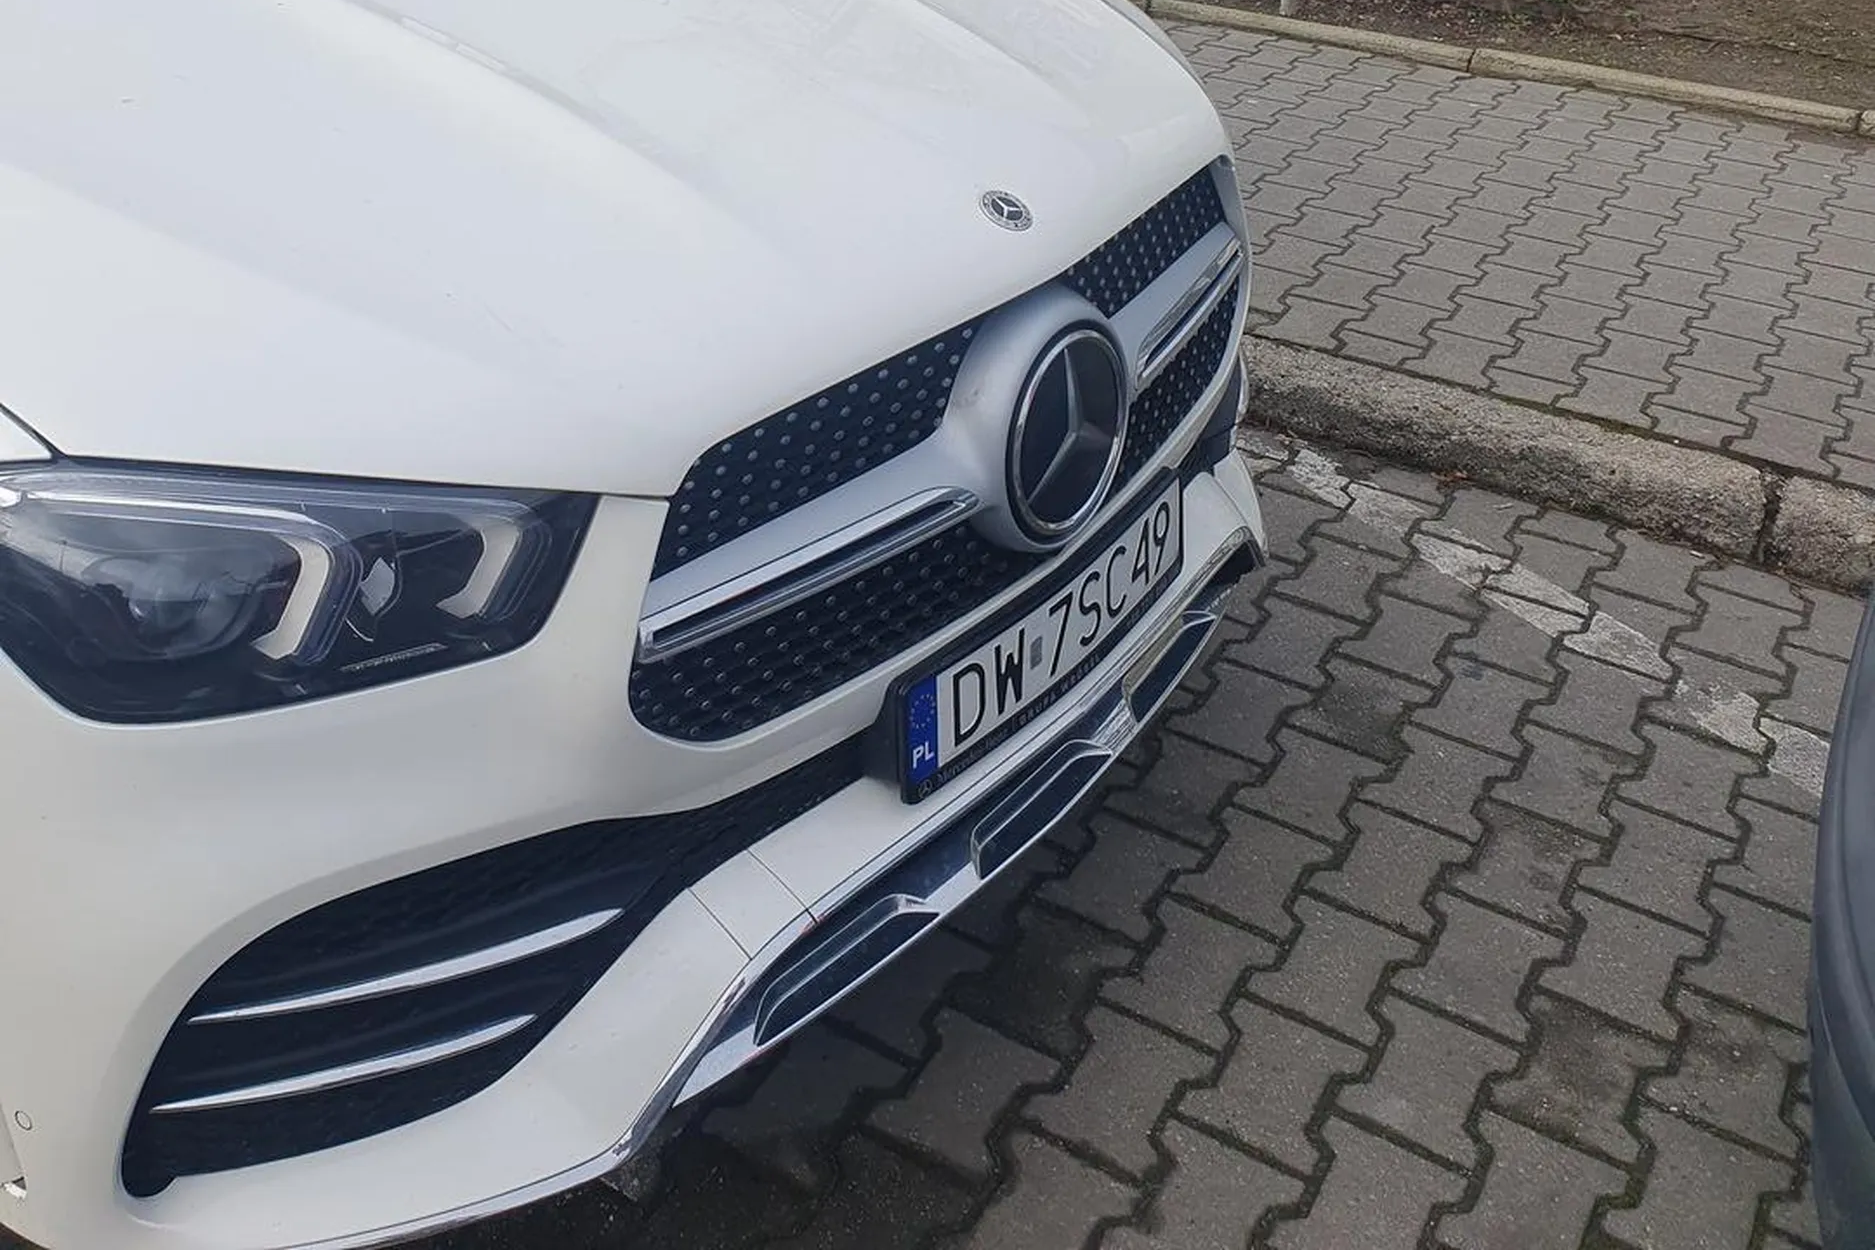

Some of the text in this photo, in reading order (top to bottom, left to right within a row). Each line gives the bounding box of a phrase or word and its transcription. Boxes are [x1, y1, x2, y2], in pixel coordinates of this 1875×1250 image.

[952, 626, 1026, 747] DW
[1047, 500, 1170, 678] 7SC49
[912, 740, 935, 770] PL
